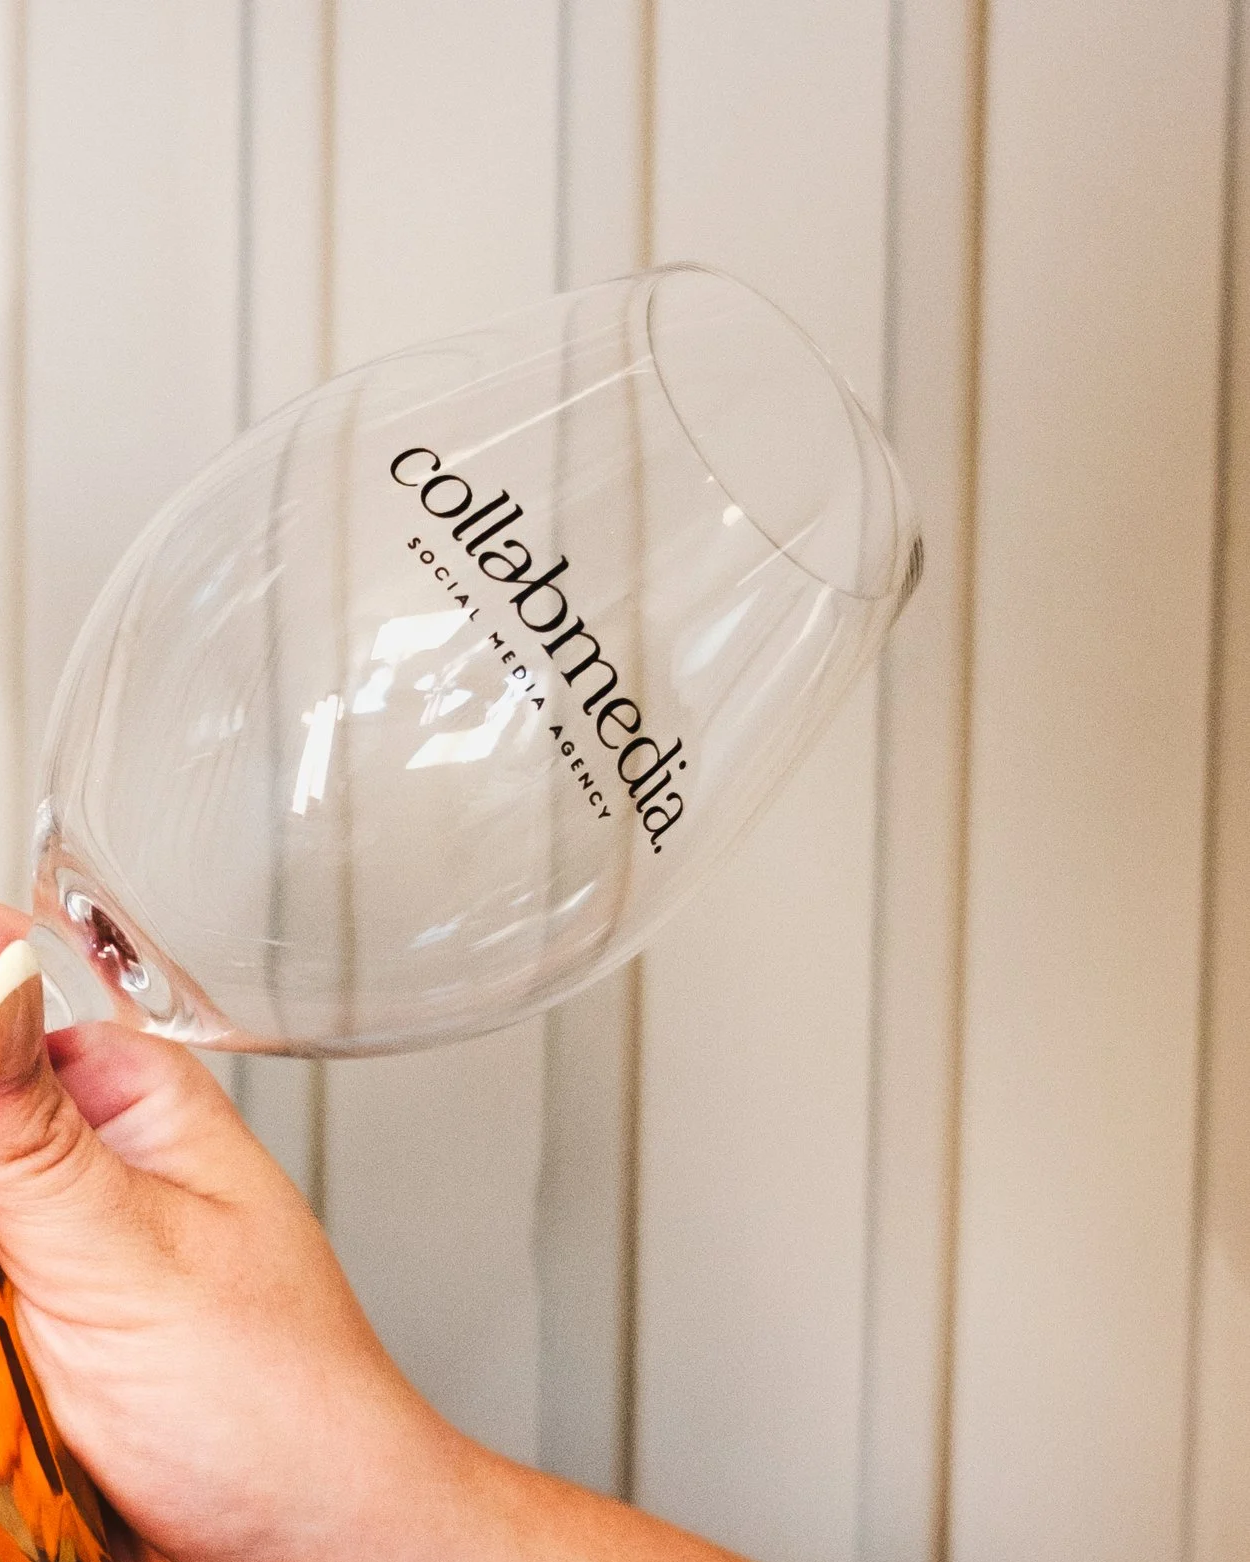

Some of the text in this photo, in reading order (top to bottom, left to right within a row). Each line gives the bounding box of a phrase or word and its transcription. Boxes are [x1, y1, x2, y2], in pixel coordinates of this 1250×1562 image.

[390, 447, 687, 855] collabmedia.
[407, 536, 612, 820] SOCIAL MEDIA AGENCY
